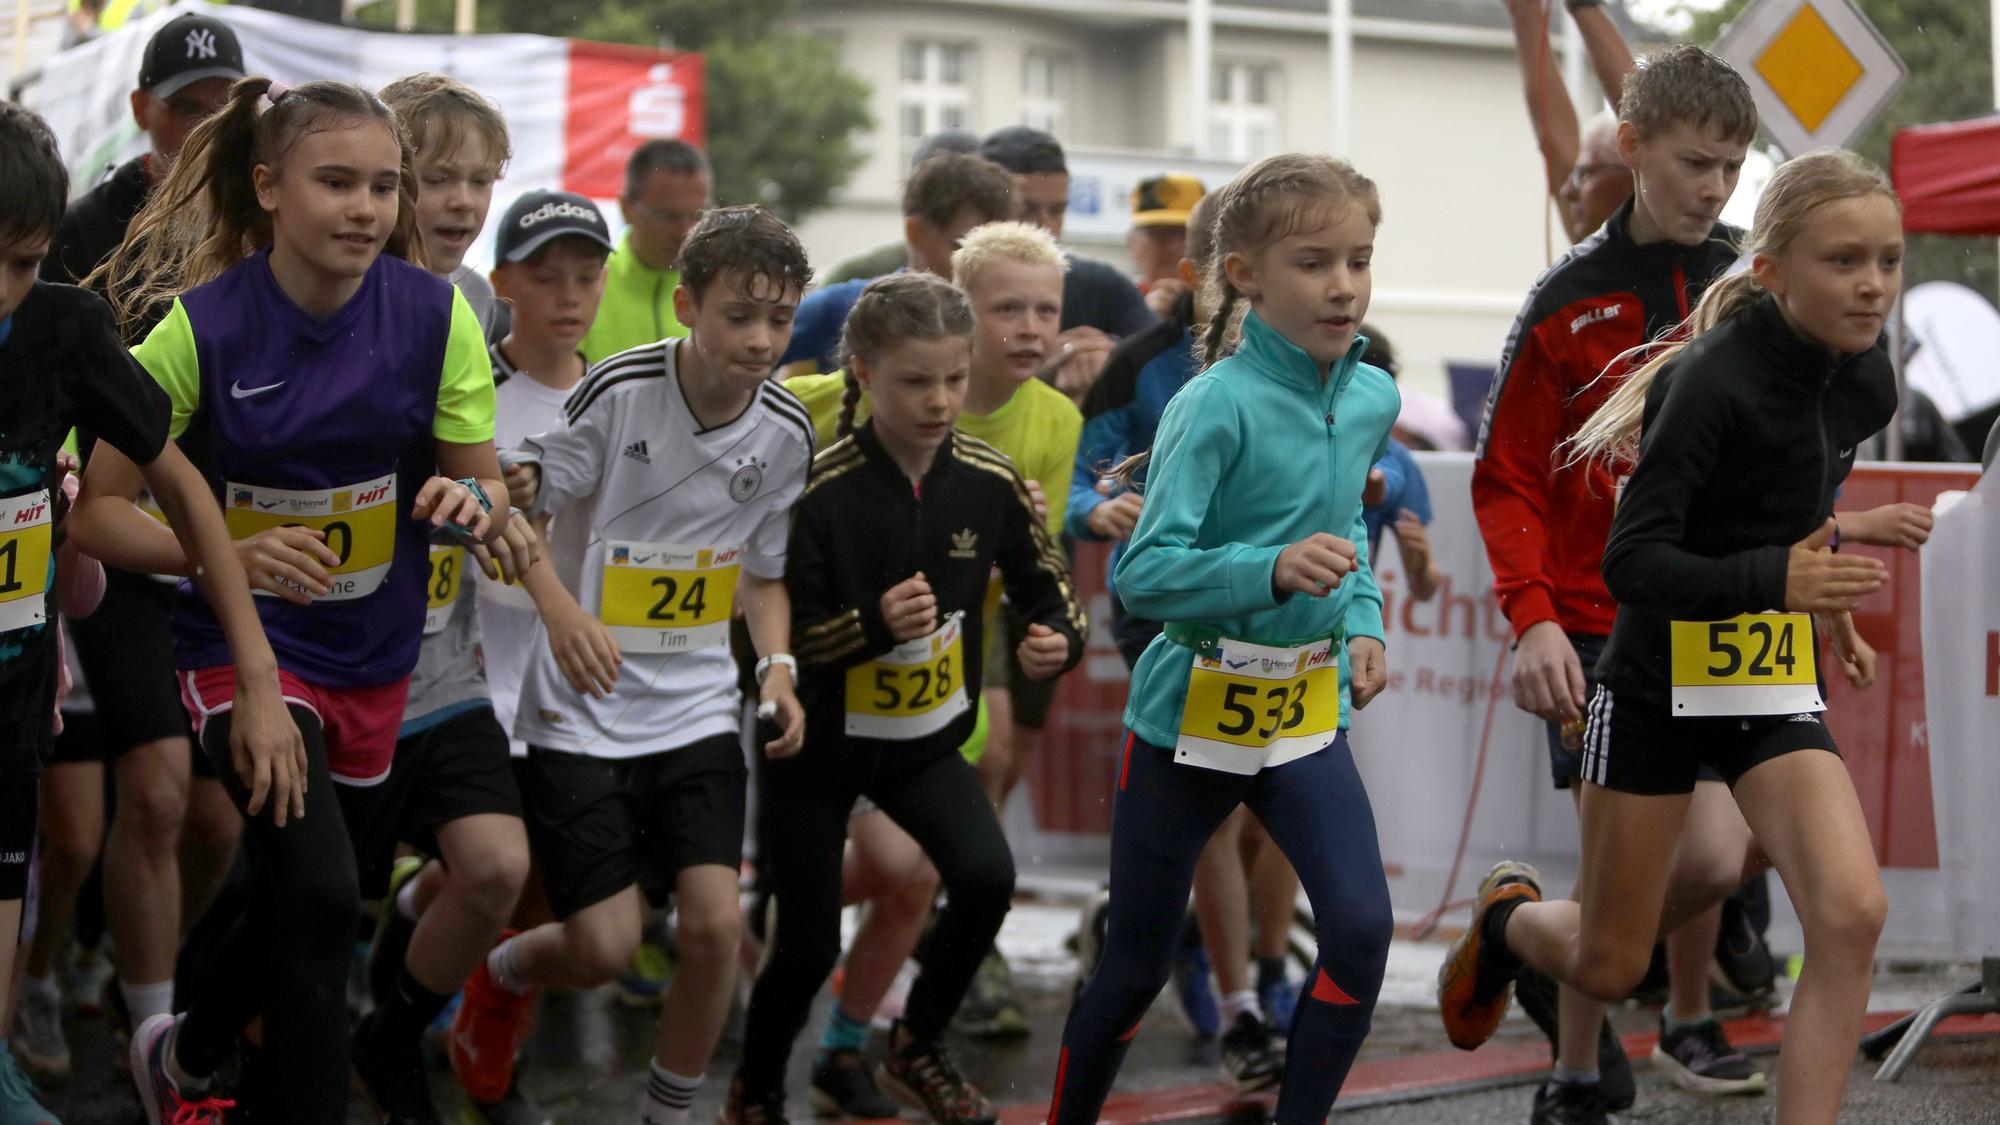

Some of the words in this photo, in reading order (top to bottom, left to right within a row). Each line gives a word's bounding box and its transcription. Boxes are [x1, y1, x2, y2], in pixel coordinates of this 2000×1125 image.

[185, 28, 217, 58] NY
[520, 202, 598, 229] adidas
[356, 484, 391, 506] HIT
[14, 504, 45, 524] HIT
[714, 550, 738, 564] HIT
[427, 555, 454, 600] 8
[647, 576, 706, 620] 24
[659, 631, 687, 647] Tim
[1708, 621, 1796, 677] 524
[873, 654, 952, 710] 528
[1217, 679, 1308, 739] 533
